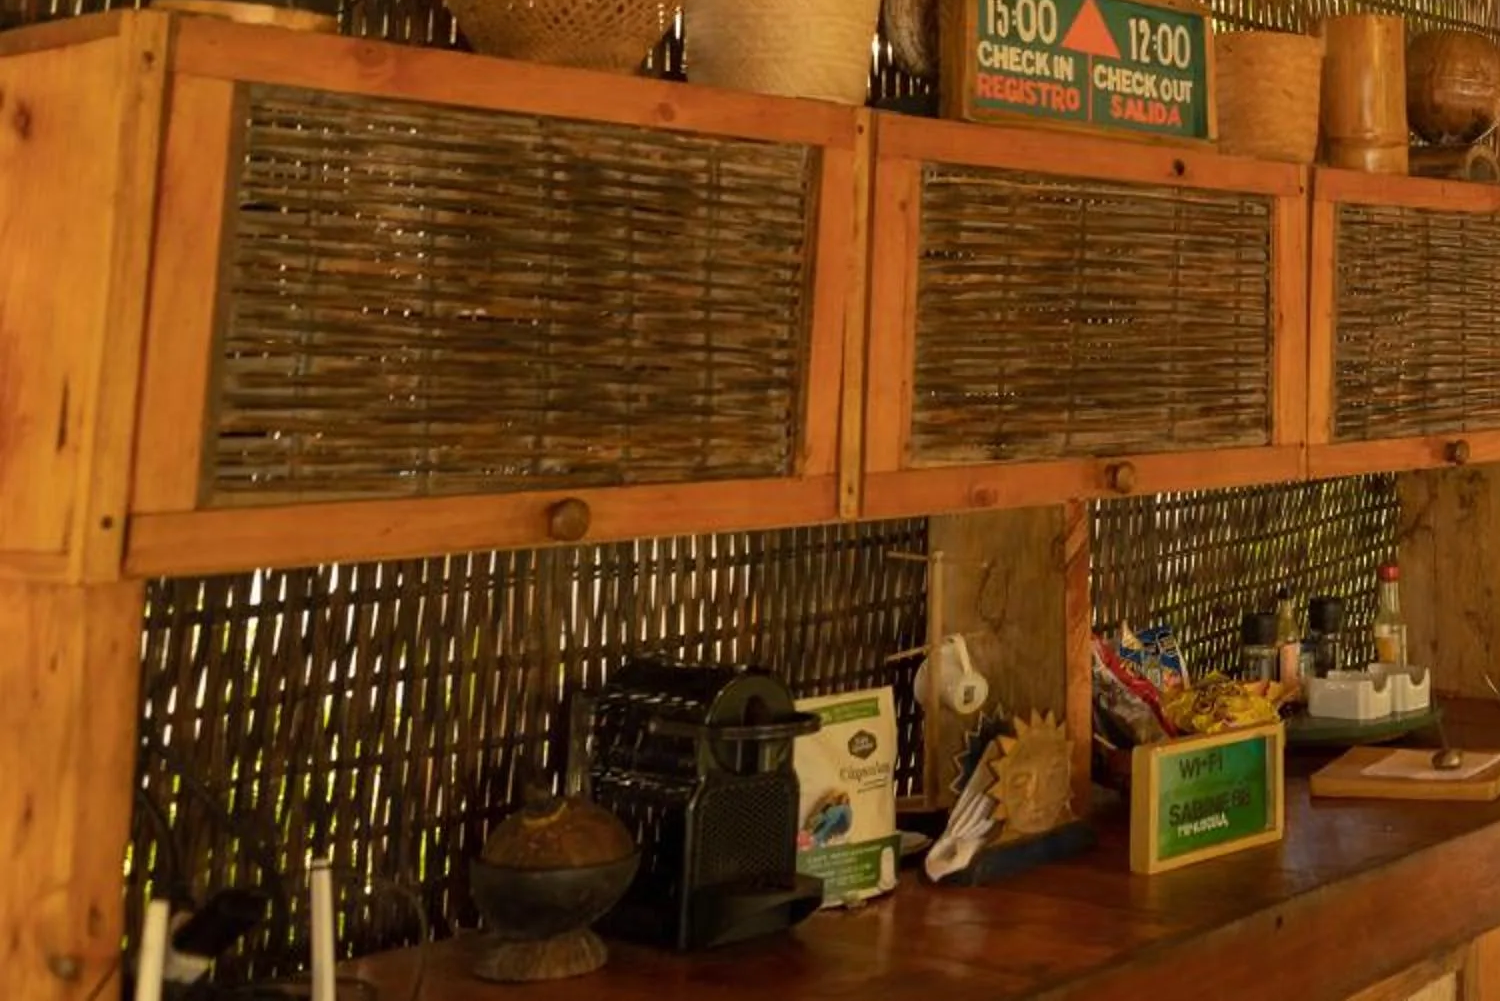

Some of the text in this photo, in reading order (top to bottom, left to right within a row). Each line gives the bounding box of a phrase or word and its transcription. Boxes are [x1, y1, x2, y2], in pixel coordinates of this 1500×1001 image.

[977, 40, 1075, 82] CHECK IN
[1129, 18, 1191, 69] 12:00
[977, 73, 1081, 113] REGISTRO
[1093, 64, 1193, 103] CHECK OUT
[1110, 95, 1182, 126] SALIDA
